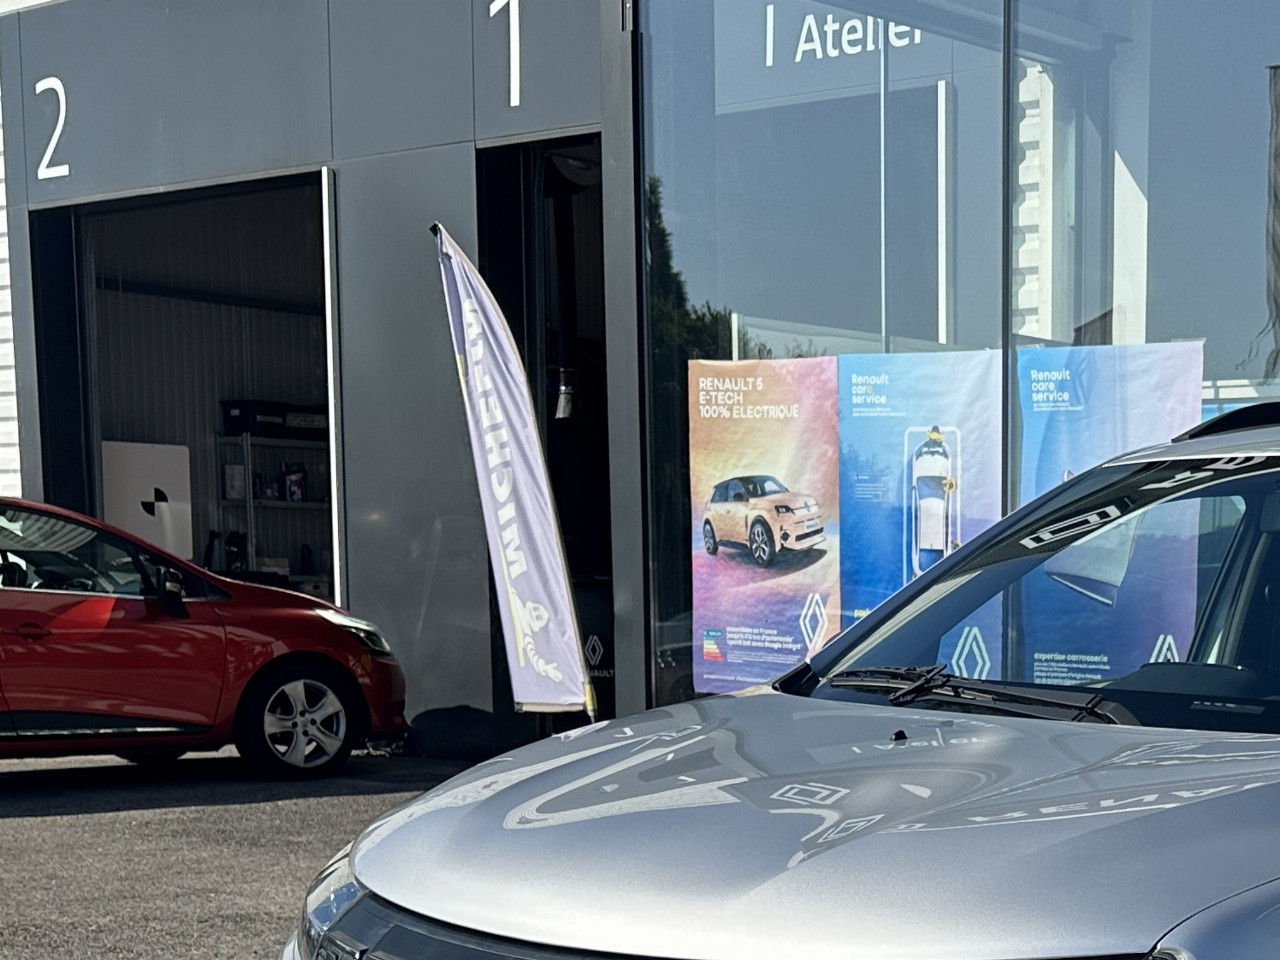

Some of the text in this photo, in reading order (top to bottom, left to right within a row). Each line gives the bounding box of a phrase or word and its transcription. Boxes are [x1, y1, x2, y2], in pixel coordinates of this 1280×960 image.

[489, 0, 520, 107] 1
[35, 76, 69, 179] 2
[851, 373, 889, 385] Renault
[1030, 368, 1071, 381] Renault
[699, 377, 763, 391] RENAULT 5
[1031, 381, 1055, 391] care
[699, 392, 743, 404] E-TECH
[851, 394, 888, 404] service
[1031, 390, 1070, 402] service
[699, 404, 799, 420] 100% ELECTRIQUE
